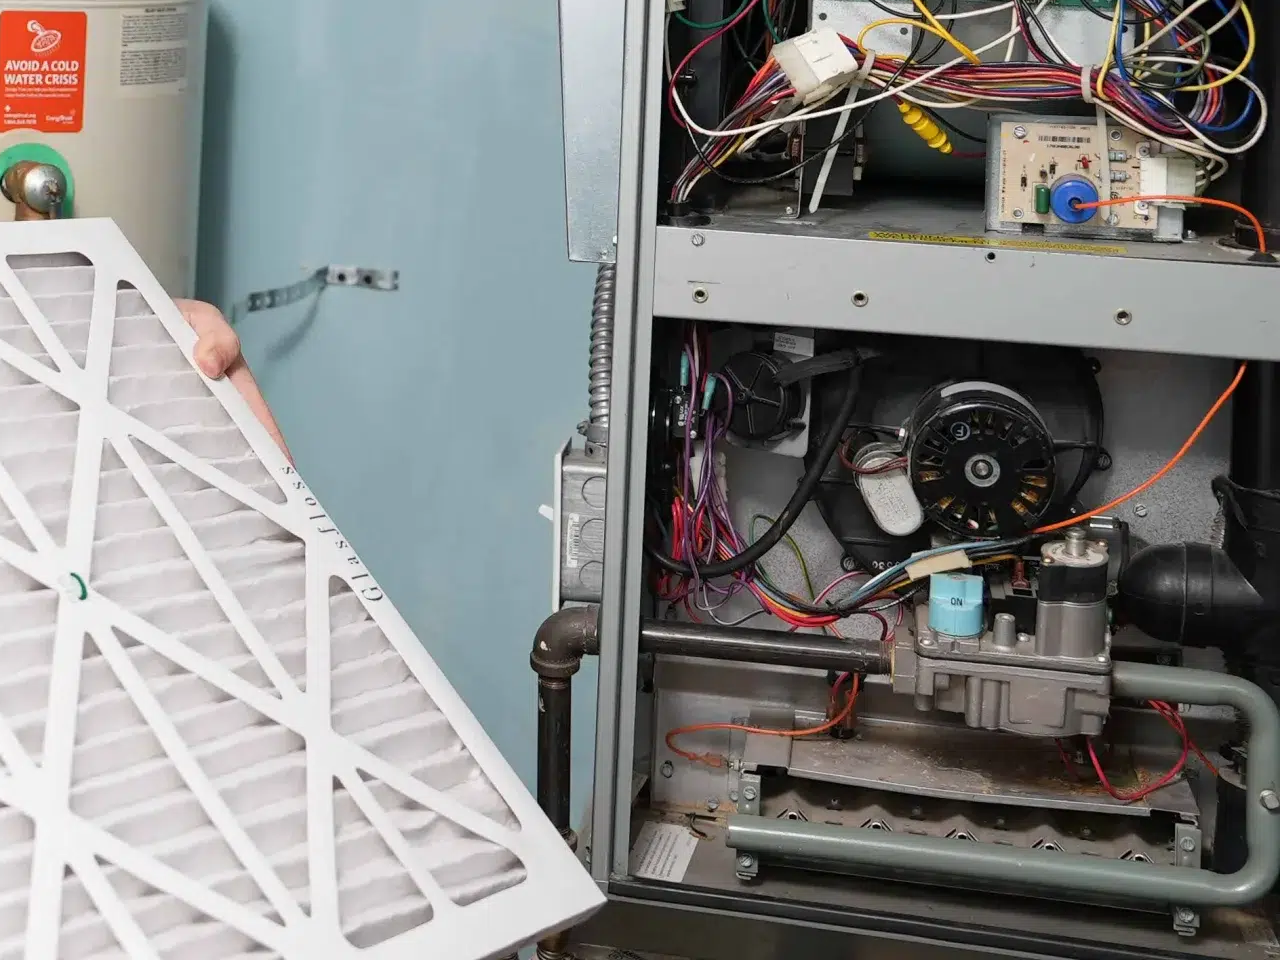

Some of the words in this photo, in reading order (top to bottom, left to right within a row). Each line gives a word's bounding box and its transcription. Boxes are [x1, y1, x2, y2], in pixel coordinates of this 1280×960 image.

[4, 60, 39, 71] AVOID
[41, 60, 50, 71] A
[51, 60, 79, 71] COLD
[4, 73, 45, 85] WATER
[45, 73, 79, 85] CRISIS
[281, 465, 384, 602] Glasfloss
[950, 597, 963, 607] ON
